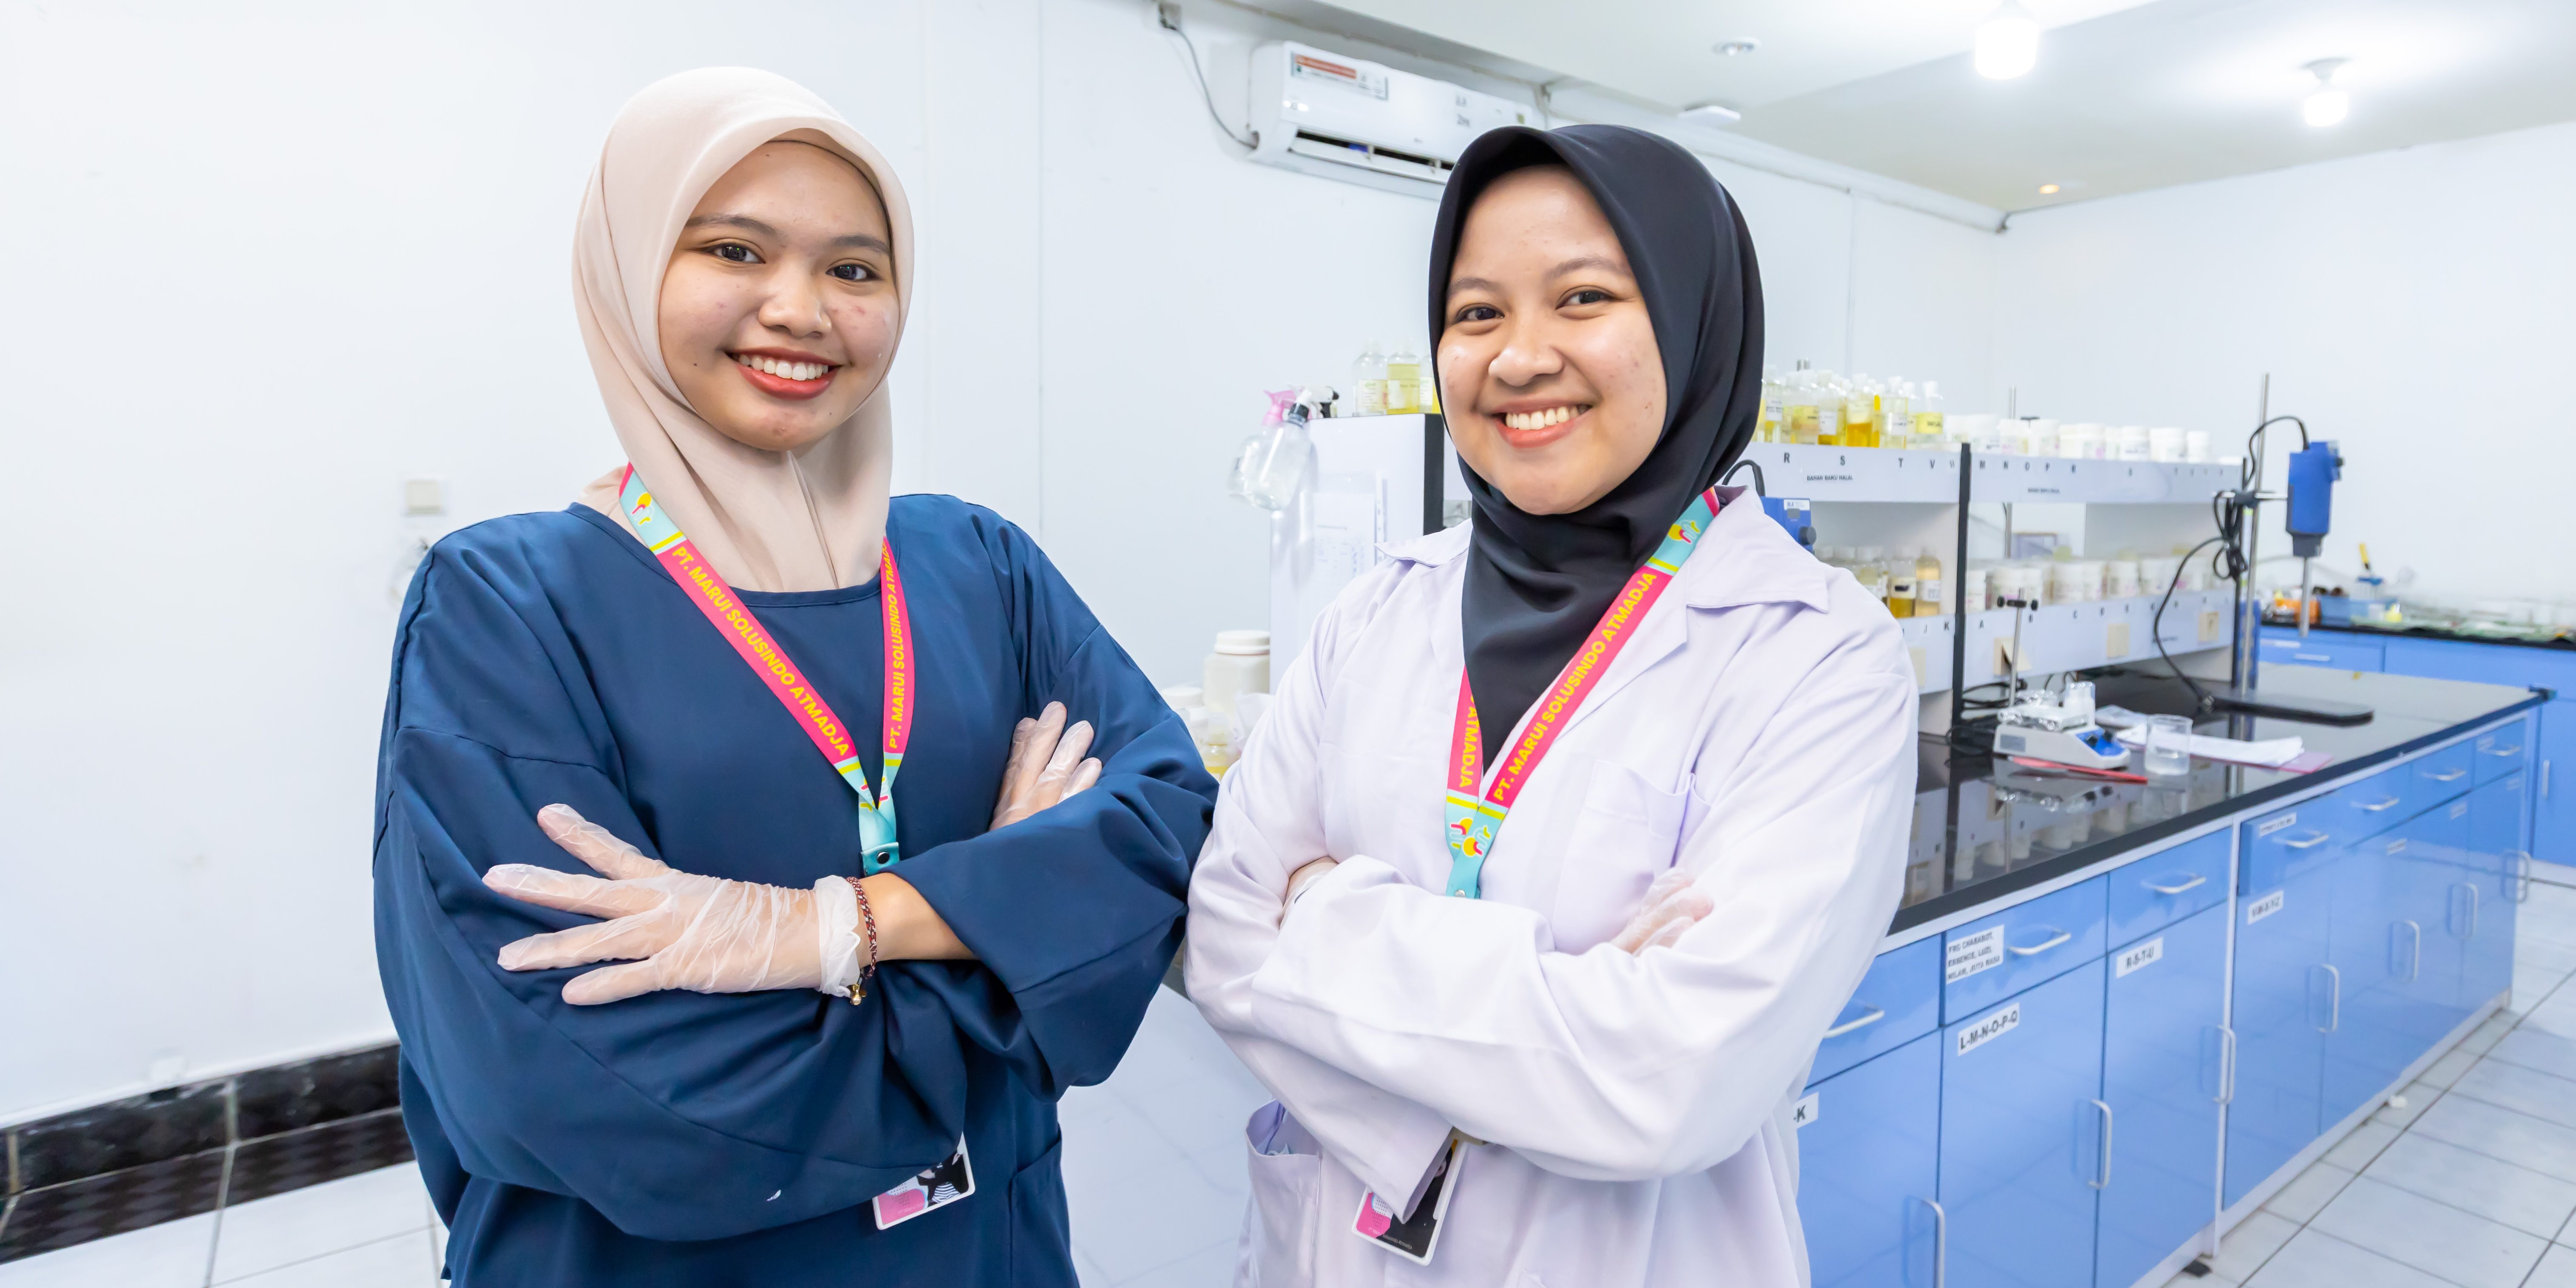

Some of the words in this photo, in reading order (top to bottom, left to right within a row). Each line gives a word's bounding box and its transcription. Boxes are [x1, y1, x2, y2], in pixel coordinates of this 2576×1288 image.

[1784, 452, 1790, 463] R
[1839, 455, 1846, 466] S
[1898, 457, 1904, 468] T
[882, 541, 896, 593] ATMADJ
[888, 594, 905, 670] SOLUSINDO
[1943, 621, 1950, 631] K
[1979, 620, 1984, 629] A
[672, 546, 694, 570] PT.
[688, 566, 733, 612] MARUI
[726, 609, 795, 685] SOLUSINDO
[789, 687, 849, 755] ATMADJA
[891, 671, 905, 722] MARUI
[1493, 778, 1515, 801] PT.
[1508, 722, 1548, 775] MARUI
[1542, 641, 1606, 723] SOLUSINDO
[1602, 573, 1657, 642] ATMADJA
[889, 726, 901, 749] PT.
[1459, 706, 1480, 788] ATMADJA
[1960, 1010, 2018, 1050] L-M-N-O-P-Q
